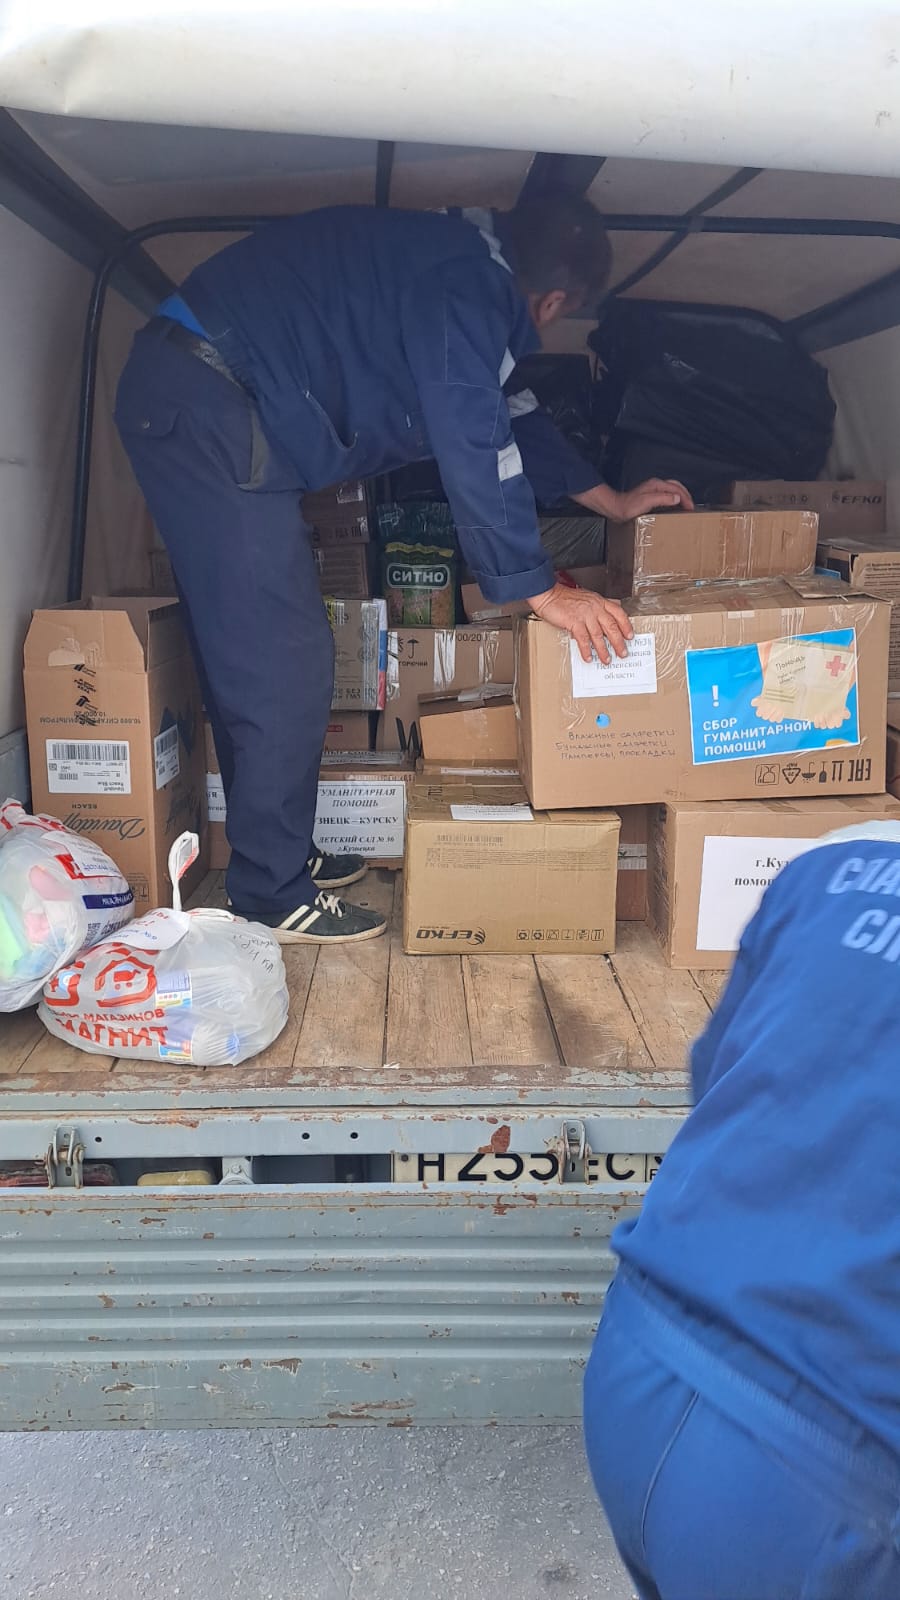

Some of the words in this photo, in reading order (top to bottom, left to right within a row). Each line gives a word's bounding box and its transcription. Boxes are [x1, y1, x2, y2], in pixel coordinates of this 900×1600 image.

[841, 495, 882, 504] EFKO
[392, 570, 444, 583] СИТНО
[702, 717, 738, 731] СБОР
[703, 720, 812, 744] ГУМАНИТАРНОЙ
[704, 739, 767, 756] ПОМОЩИ
[320, 787, 397, 798] УМАНИТАРНАЯ
[332, 799, 379, 808] ПОМОЩЬ
[62, 812, 146, 841] Davidoff
[317, 817, 350, 825] ЗНЕЦК
[359, 816, 399, 825] КУРСКУ
[755, 857, 790, 870] г.Ку
[825, 857, 900, 897] СТА
[416, 929, 473, 940] EFKO
[83, 1008, 166, 1022] МАГАЗИНОВ
